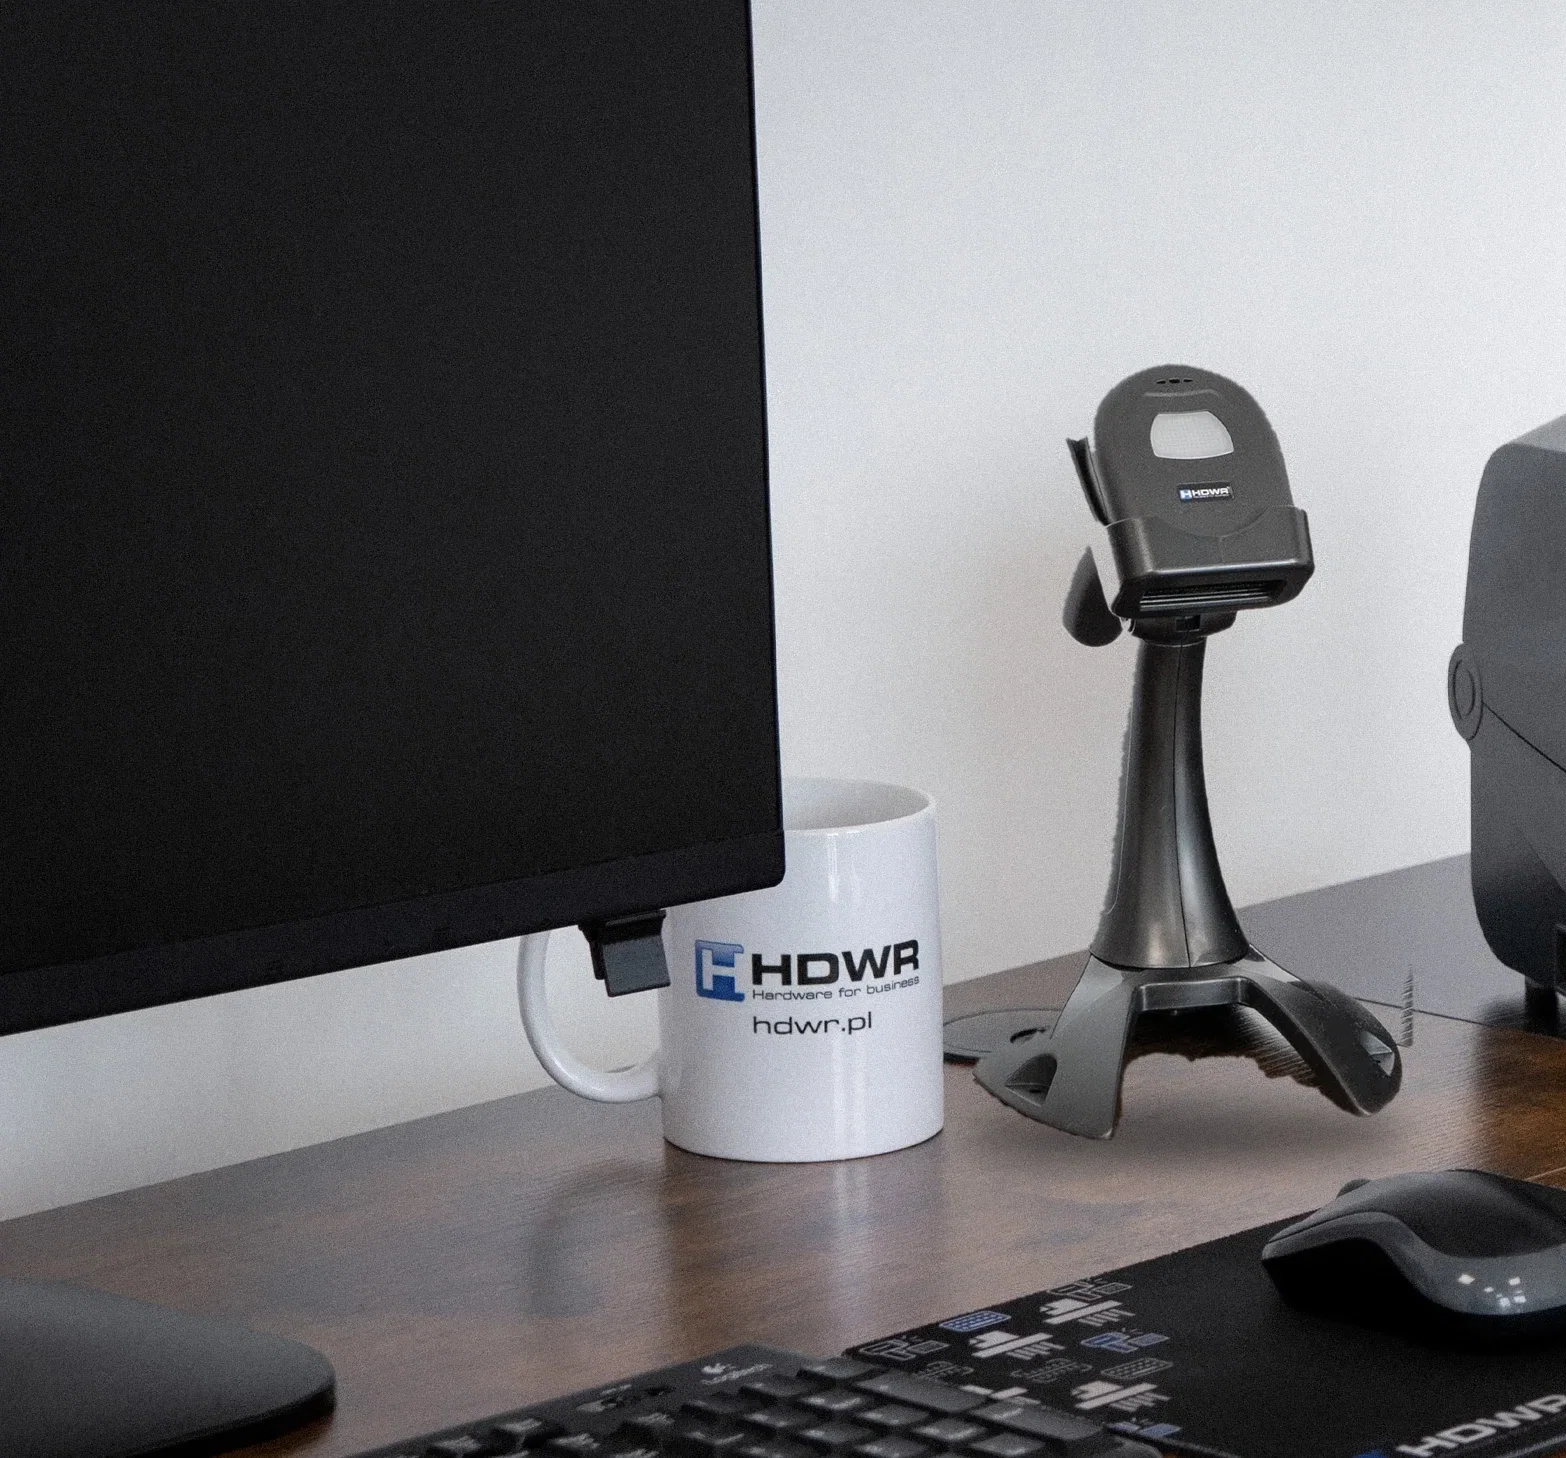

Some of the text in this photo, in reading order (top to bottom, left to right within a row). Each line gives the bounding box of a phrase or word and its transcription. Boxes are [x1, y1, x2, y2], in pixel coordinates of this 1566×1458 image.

[1192, 487, 1229, 496] HDWR
[752, 939, 919, 986] HDWR
[752, 976, 920, 1001] Hardware for business
[752, 1011, 872, 1035] hdwr.pl
